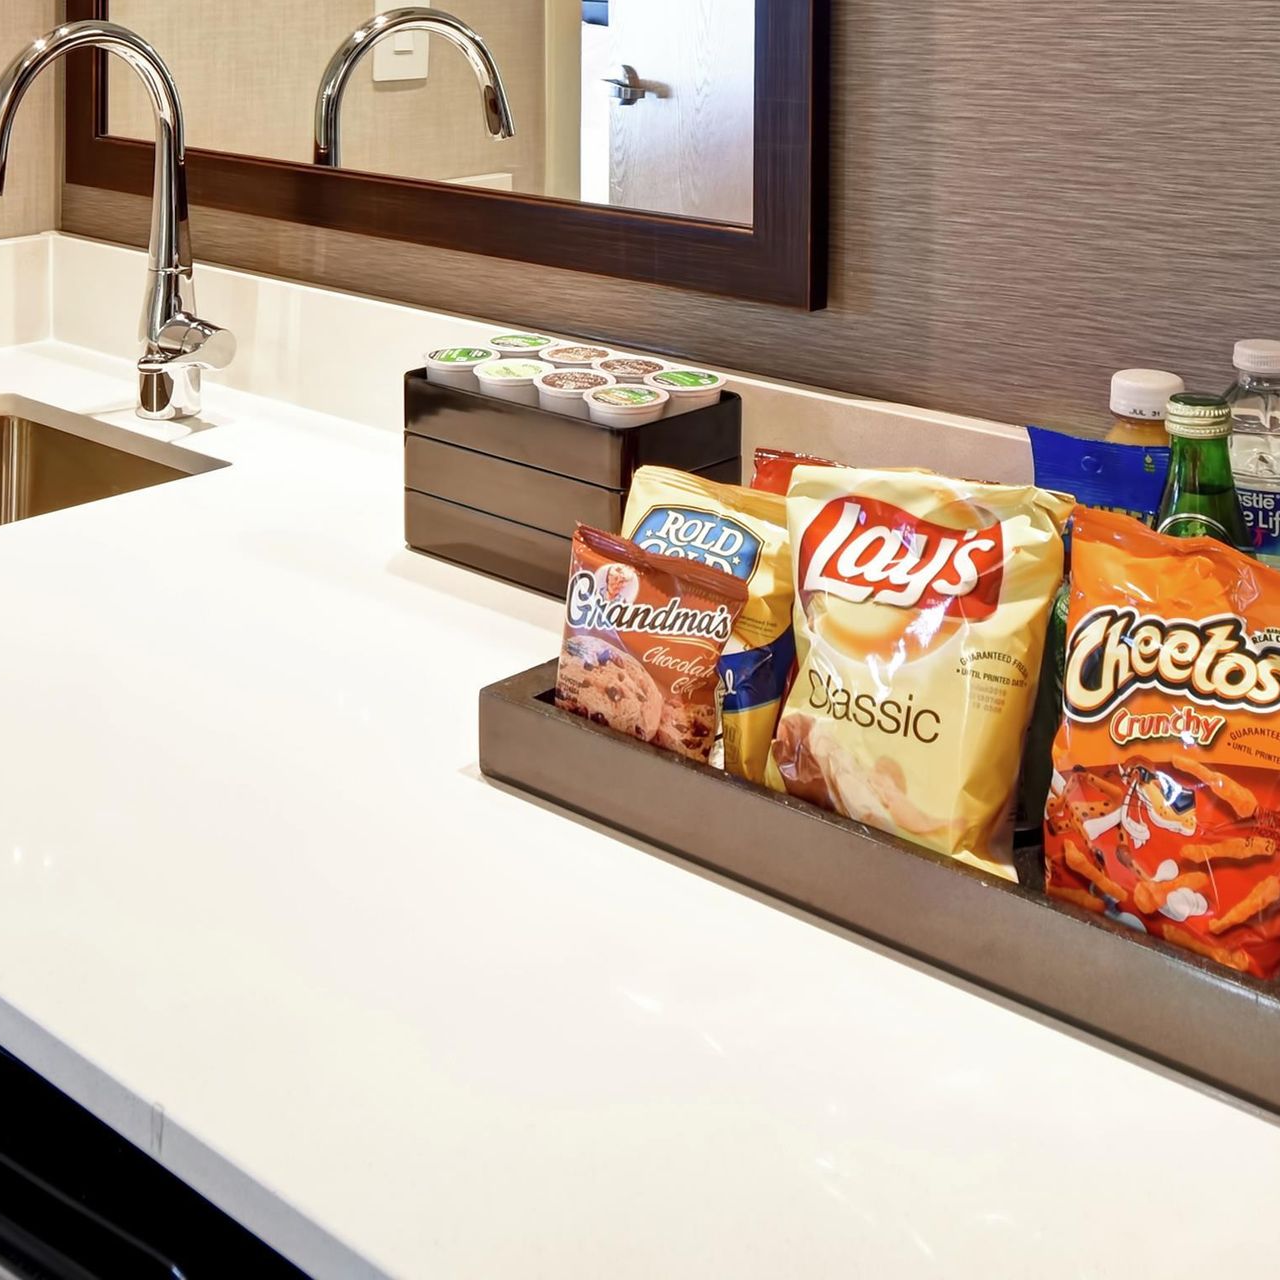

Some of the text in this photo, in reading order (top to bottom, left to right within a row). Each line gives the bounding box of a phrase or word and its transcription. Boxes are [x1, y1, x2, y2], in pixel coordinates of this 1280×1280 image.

[655, 511, 744, 557] ROLD
[804, 502, 996, 608] Lay's
[568, 571, 730, 640] Grandma's
[1251, 634, 1273, 644] REAL
[983, 673, 1010, 685] PRINTED
[808, 669, 941, 743] Classic
[1111, 707, 1225, 745] Crunchy
[1232, 741, 1253, 756] UNTIL
